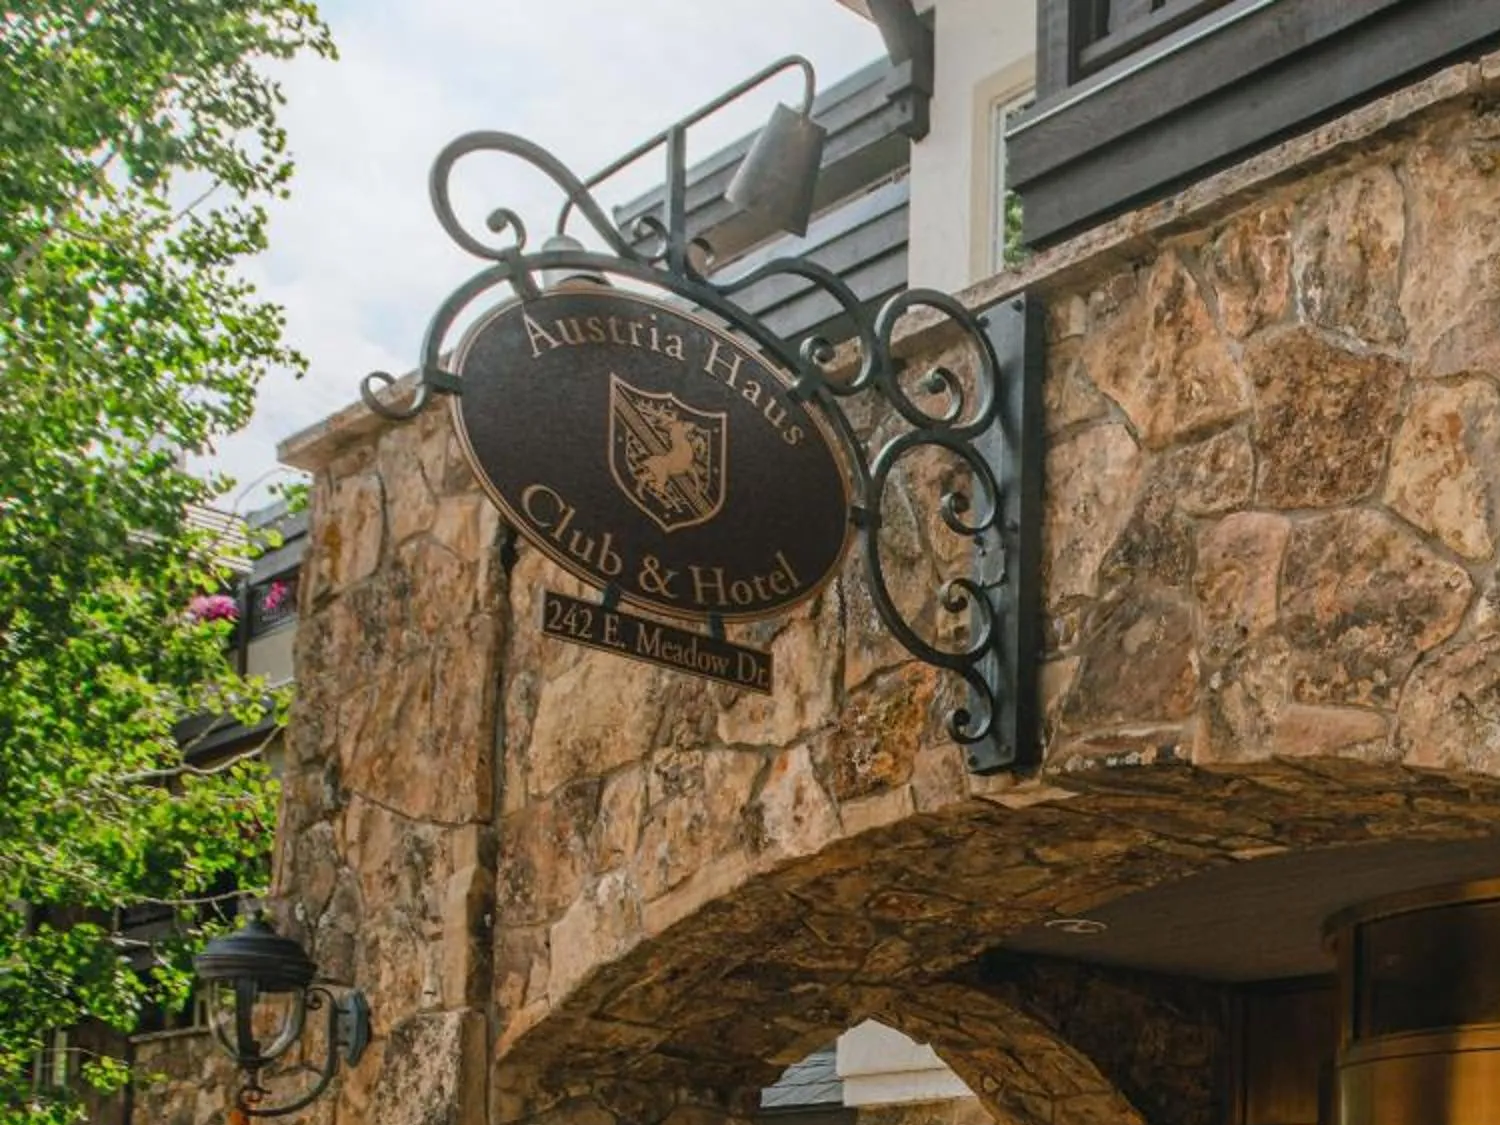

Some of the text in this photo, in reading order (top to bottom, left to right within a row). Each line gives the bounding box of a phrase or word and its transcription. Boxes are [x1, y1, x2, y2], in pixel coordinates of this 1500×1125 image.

[522, 312, 806, 447] Austria Haus
[521, 483, 801, 606] Club & Hotel
[548, 600, 594, 639] 242
[602, 613, 626, 649] E.
[636, 623, 730, 673] Meadow
